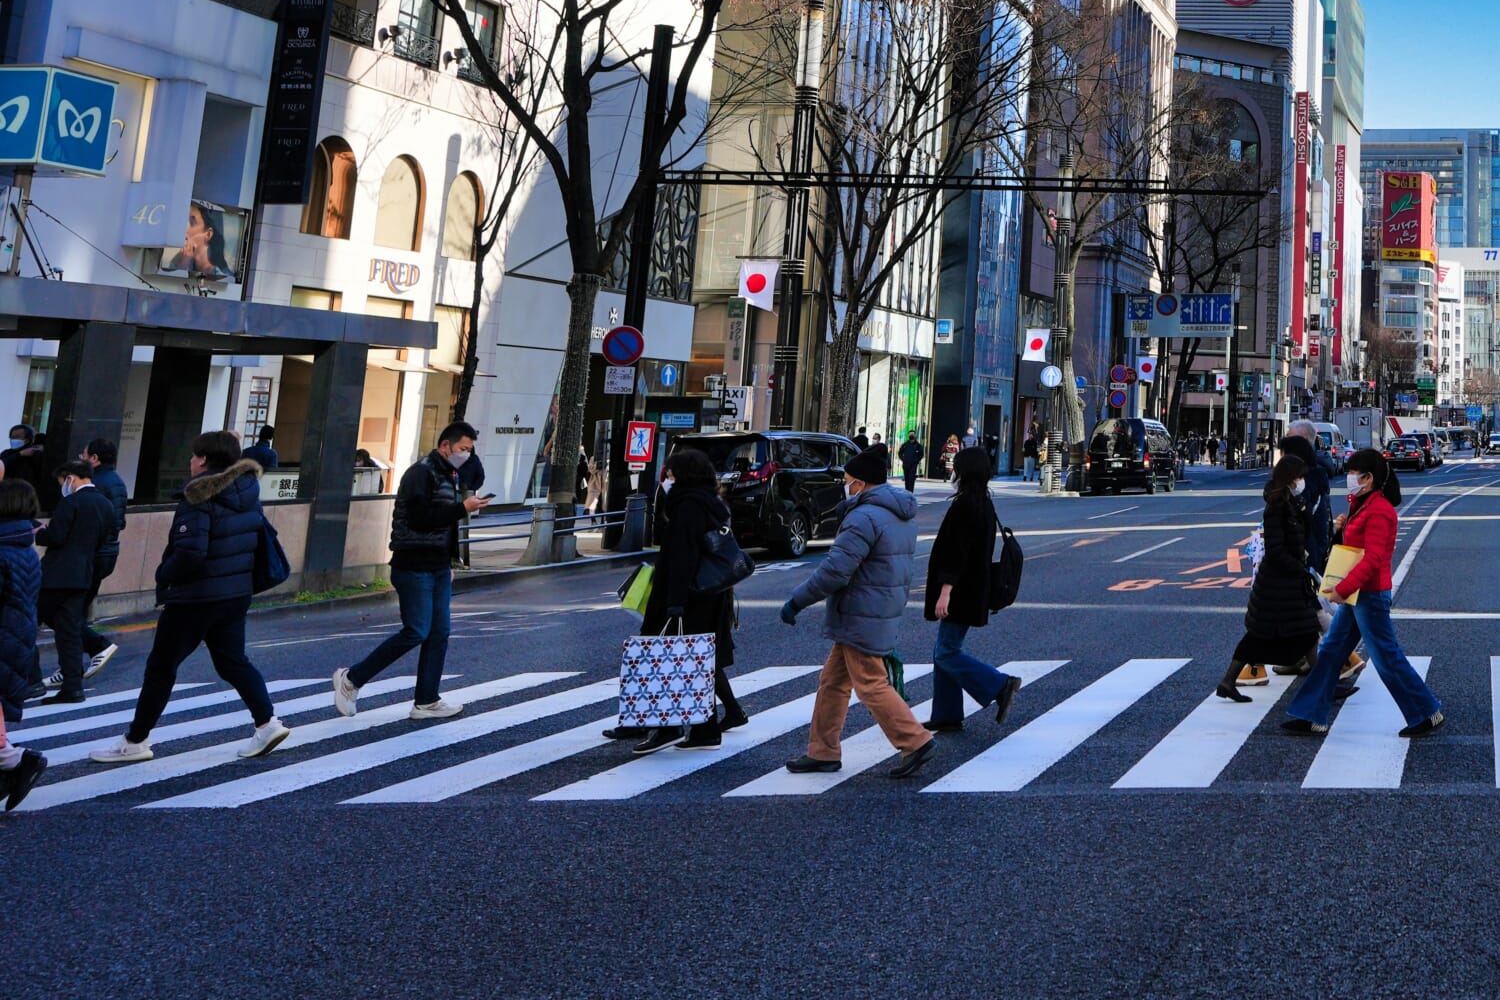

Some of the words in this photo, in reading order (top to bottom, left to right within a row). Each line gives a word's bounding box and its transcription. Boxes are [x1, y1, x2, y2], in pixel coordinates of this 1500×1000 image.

[1297, 96, 1307, 164] MITSUKOSHI
[1335, 149, 1345, 205] MITSUKOSHI
[1388, 220, 1419, 233] スパイス
[1395, 234, 1418, 245] ハーブ
[1483, 250, 1498, 261] 77
[369, 258, 421, 295] FRED
[717, 389, 744, 399] TAXI
